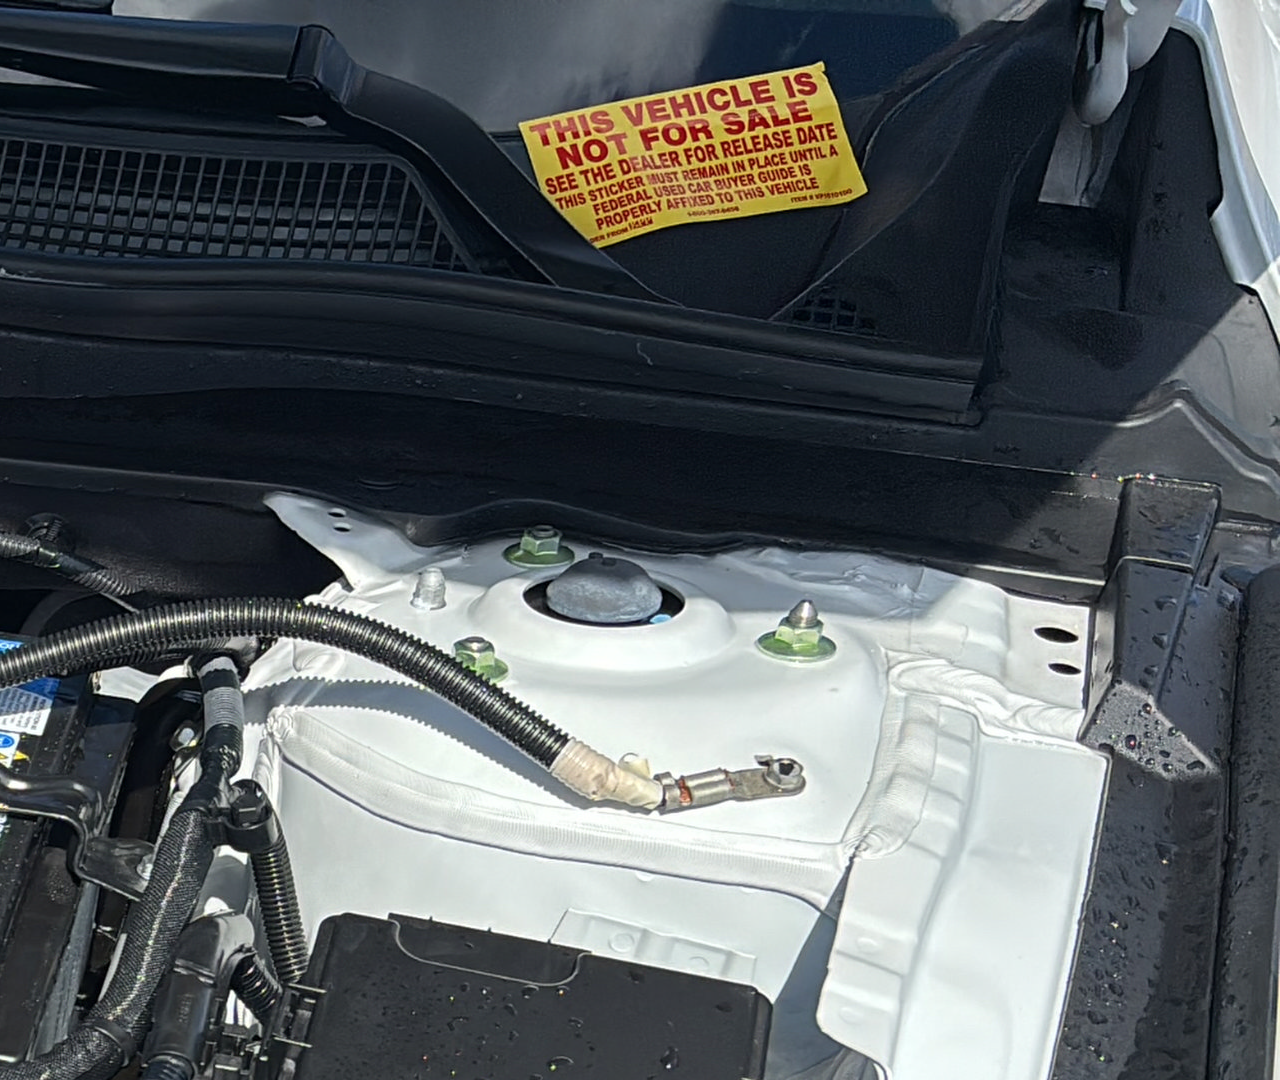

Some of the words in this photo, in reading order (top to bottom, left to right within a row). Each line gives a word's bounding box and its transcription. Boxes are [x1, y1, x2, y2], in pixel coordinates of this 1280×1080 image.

[529, 111, 615, 146] THIS
[620, 79, 772, 127] VEHICLE
[783, 72, 818, 98] IS
[555, 134, 629, 170] NOT
[639, 120, 713, 150] FOR
[720, 100, 813, 135] SALE
[545, 171, 579, 195] SEE
[581, 161, 616, 185] THE
[620, 144, 682, 174] DEALER
[685, 140, 718, 164] FOR
[722, 128, 794, 157] RELEASE
[797, 123, 837, 144] DATE
[555, 193, 586, 210] THIS
[589, 176, 644, 201] STICKER
[647, 171, 679, 185] MUST
[683, 163, 730, 181] REMAIN
[732, 162, 745, 174] IN
[748, 154, 787, 171] PLACE
[789, 148, 826, 163] UNTIL
[829, 145, 838, 159] A
[593, 189, 653, 215] FEDERAL
[653, 183, 687, 197] USED
[688, 180, 713, 194] CAR
[715, 174, 758, 191] BUYER
[760, 168, 796, 183] GUIDE
[798, 164, 812, 176] IS
[596, 203, 663, 230] PROPERLY
[666, 194, 715, 211] AFFIXED
[717, 192, 734, 205] TO
[735, 186, 764, 202] THIS
[766, 177, 819, 197] VEHICLE
